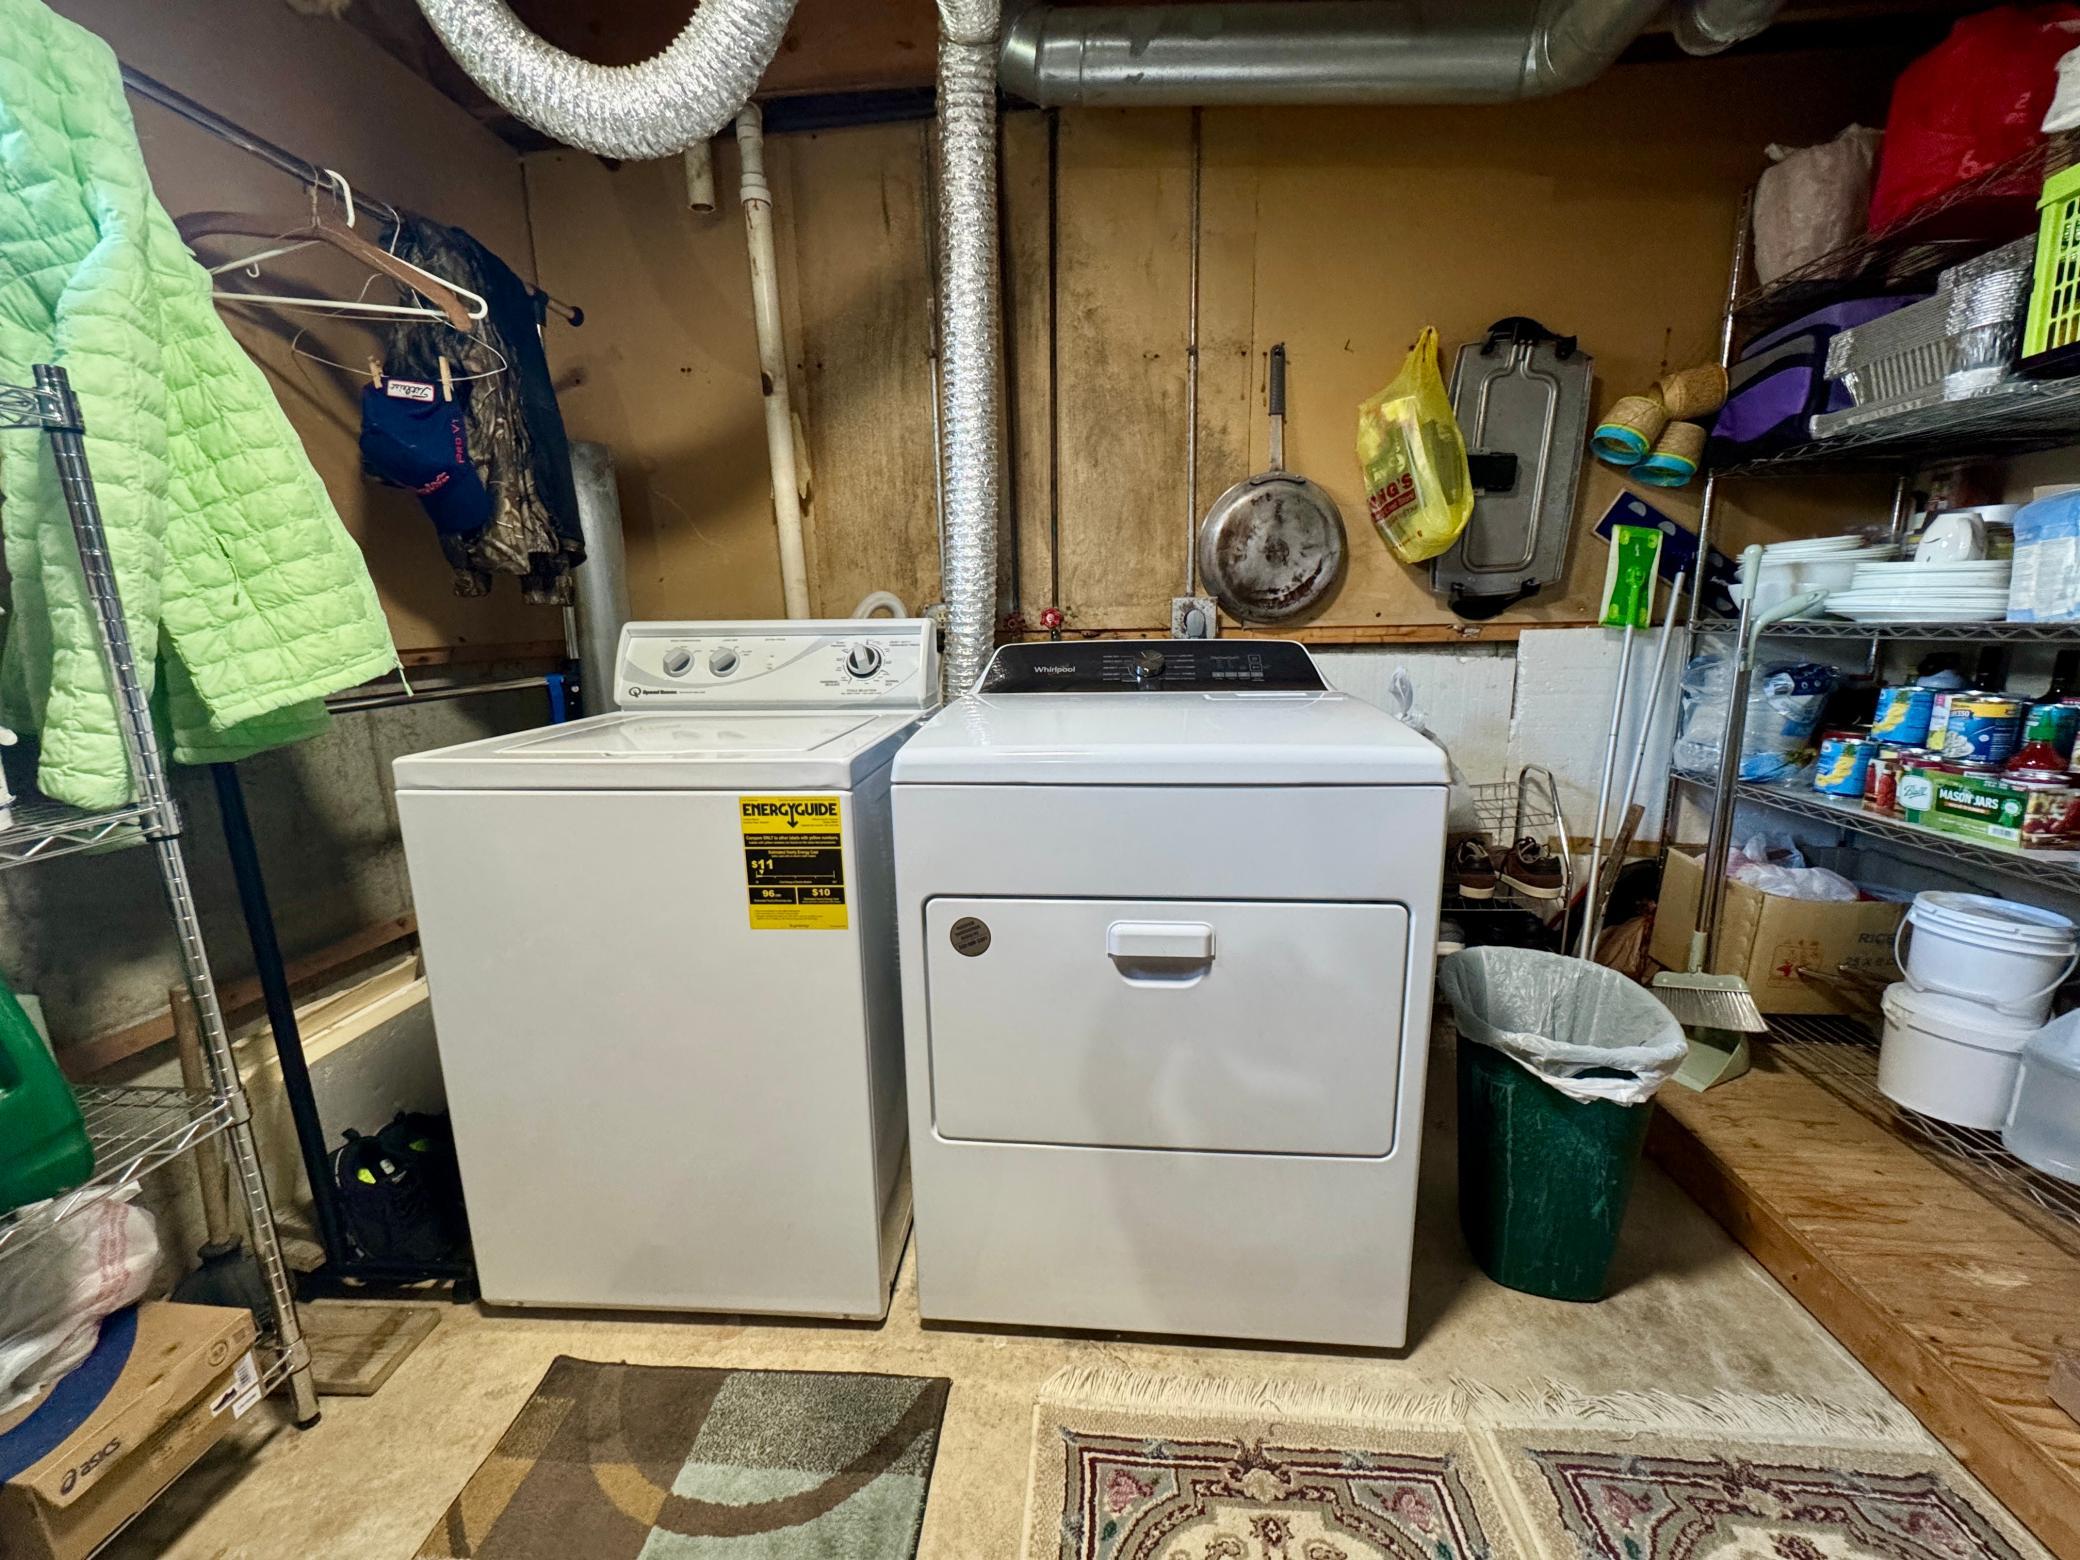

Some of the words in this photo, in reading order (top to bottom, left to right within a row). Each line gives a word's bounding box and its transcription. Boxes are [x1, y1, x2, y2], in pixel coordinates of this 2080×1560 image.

[1034, 666, 1076, 675] Whirlpool
[1939, 788, 1973, 805] MASON
[1973, 795, 1999, 810] JARS
[742, 803, 838, 817] ENERGYGUIDE
[751, 859, 774, 870] $11
[762, 889, 775, 898] 96
[812, 888, 831, 896] $10
[80, 1436, 121, 1477] asics
